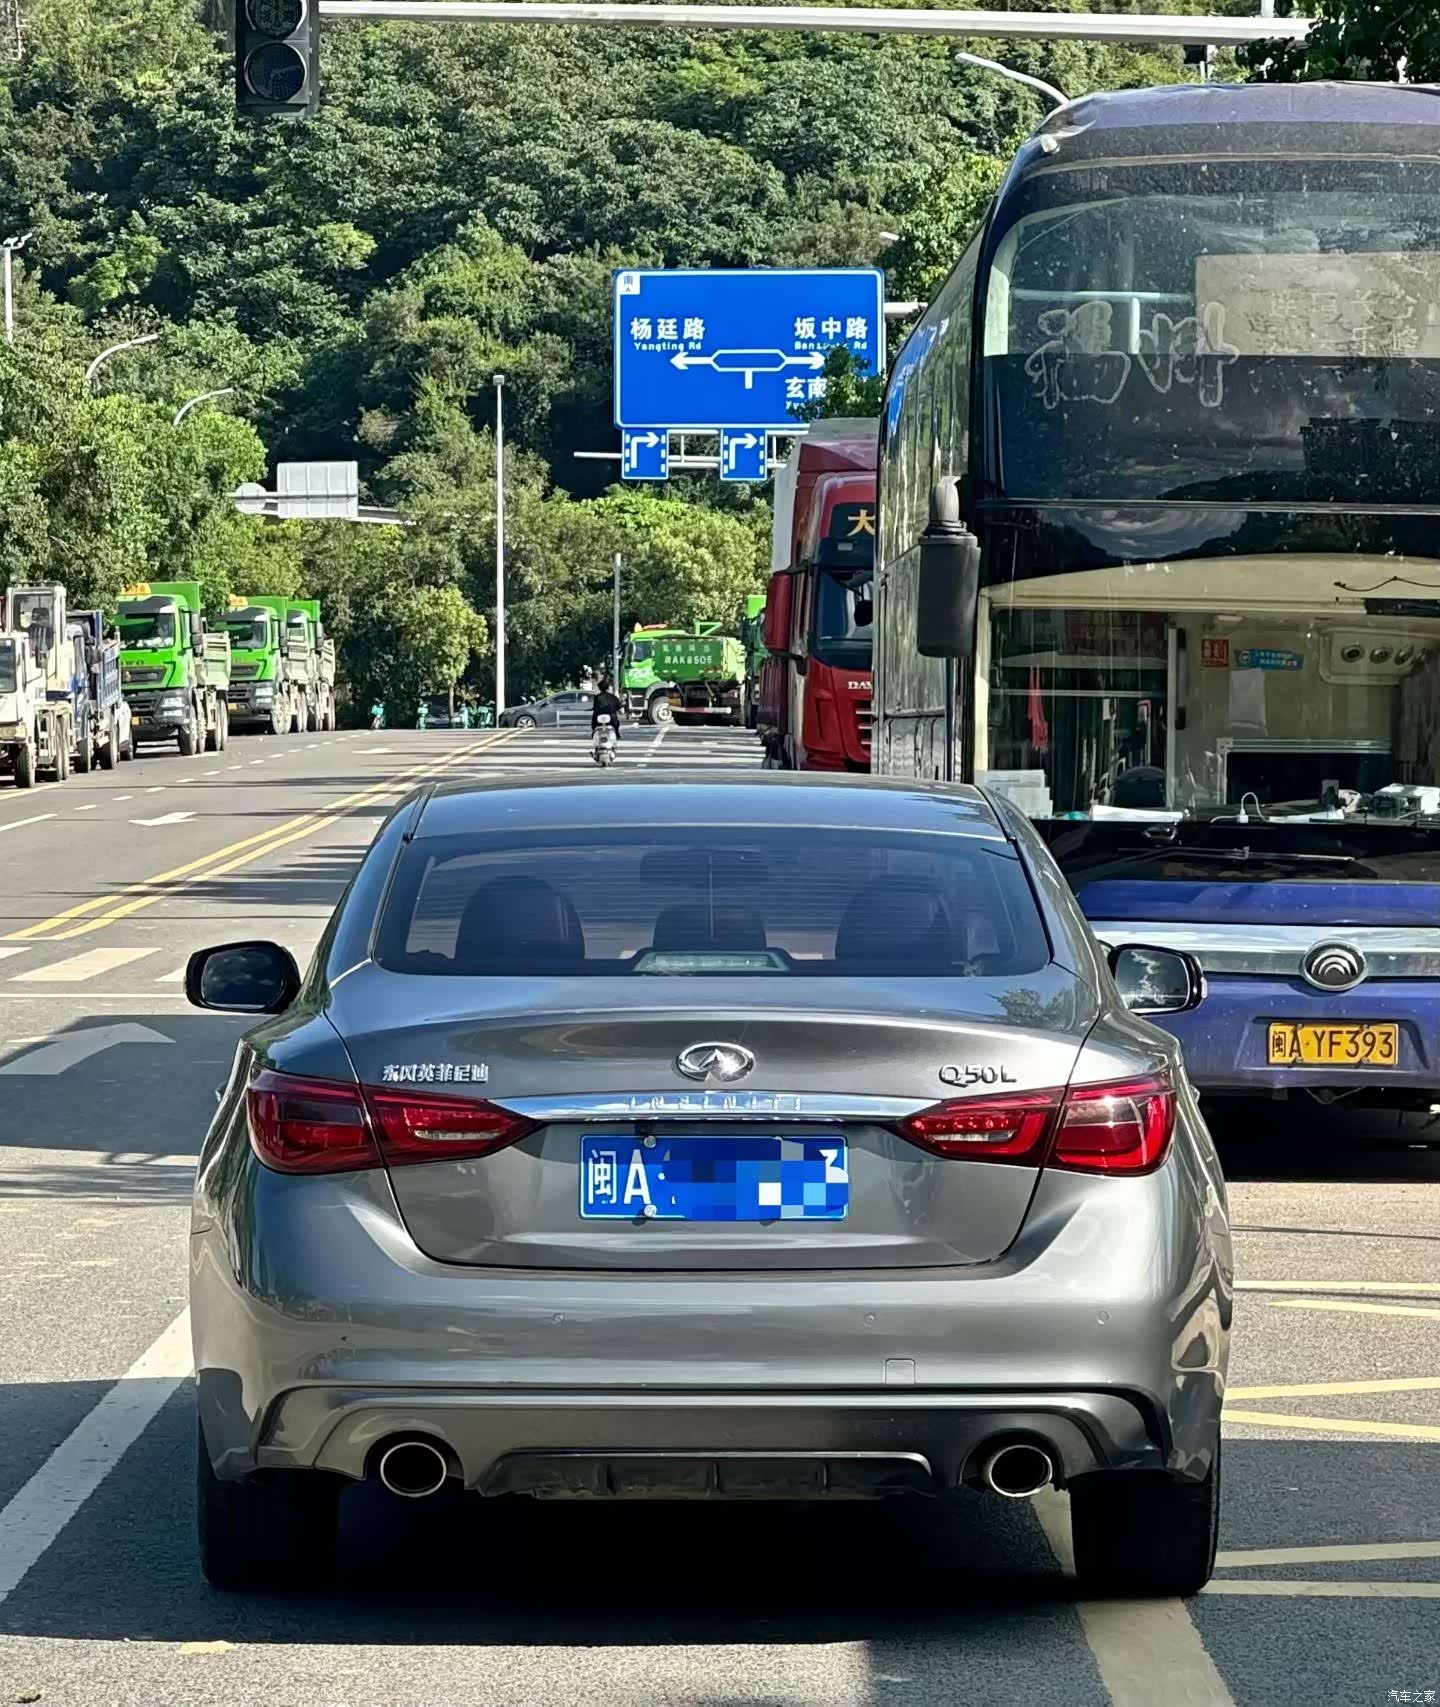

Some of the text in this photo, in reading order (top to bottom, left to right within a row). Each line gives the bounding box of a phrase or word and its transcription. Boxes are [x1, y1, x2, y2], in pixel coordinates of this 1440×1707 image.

[630, 317, 705, 340] 杨廷路
[794, 316, 868, 340] 坂中路
[634, 341, 702, 352] Yangting Rd
[854, 341, 868, 350] Rd
[848, 509, 876, 536] 大
[382, 1063, 489, 1082] 东风英菲尼迪
[939, 1064, 1017, 1088] Q50L
